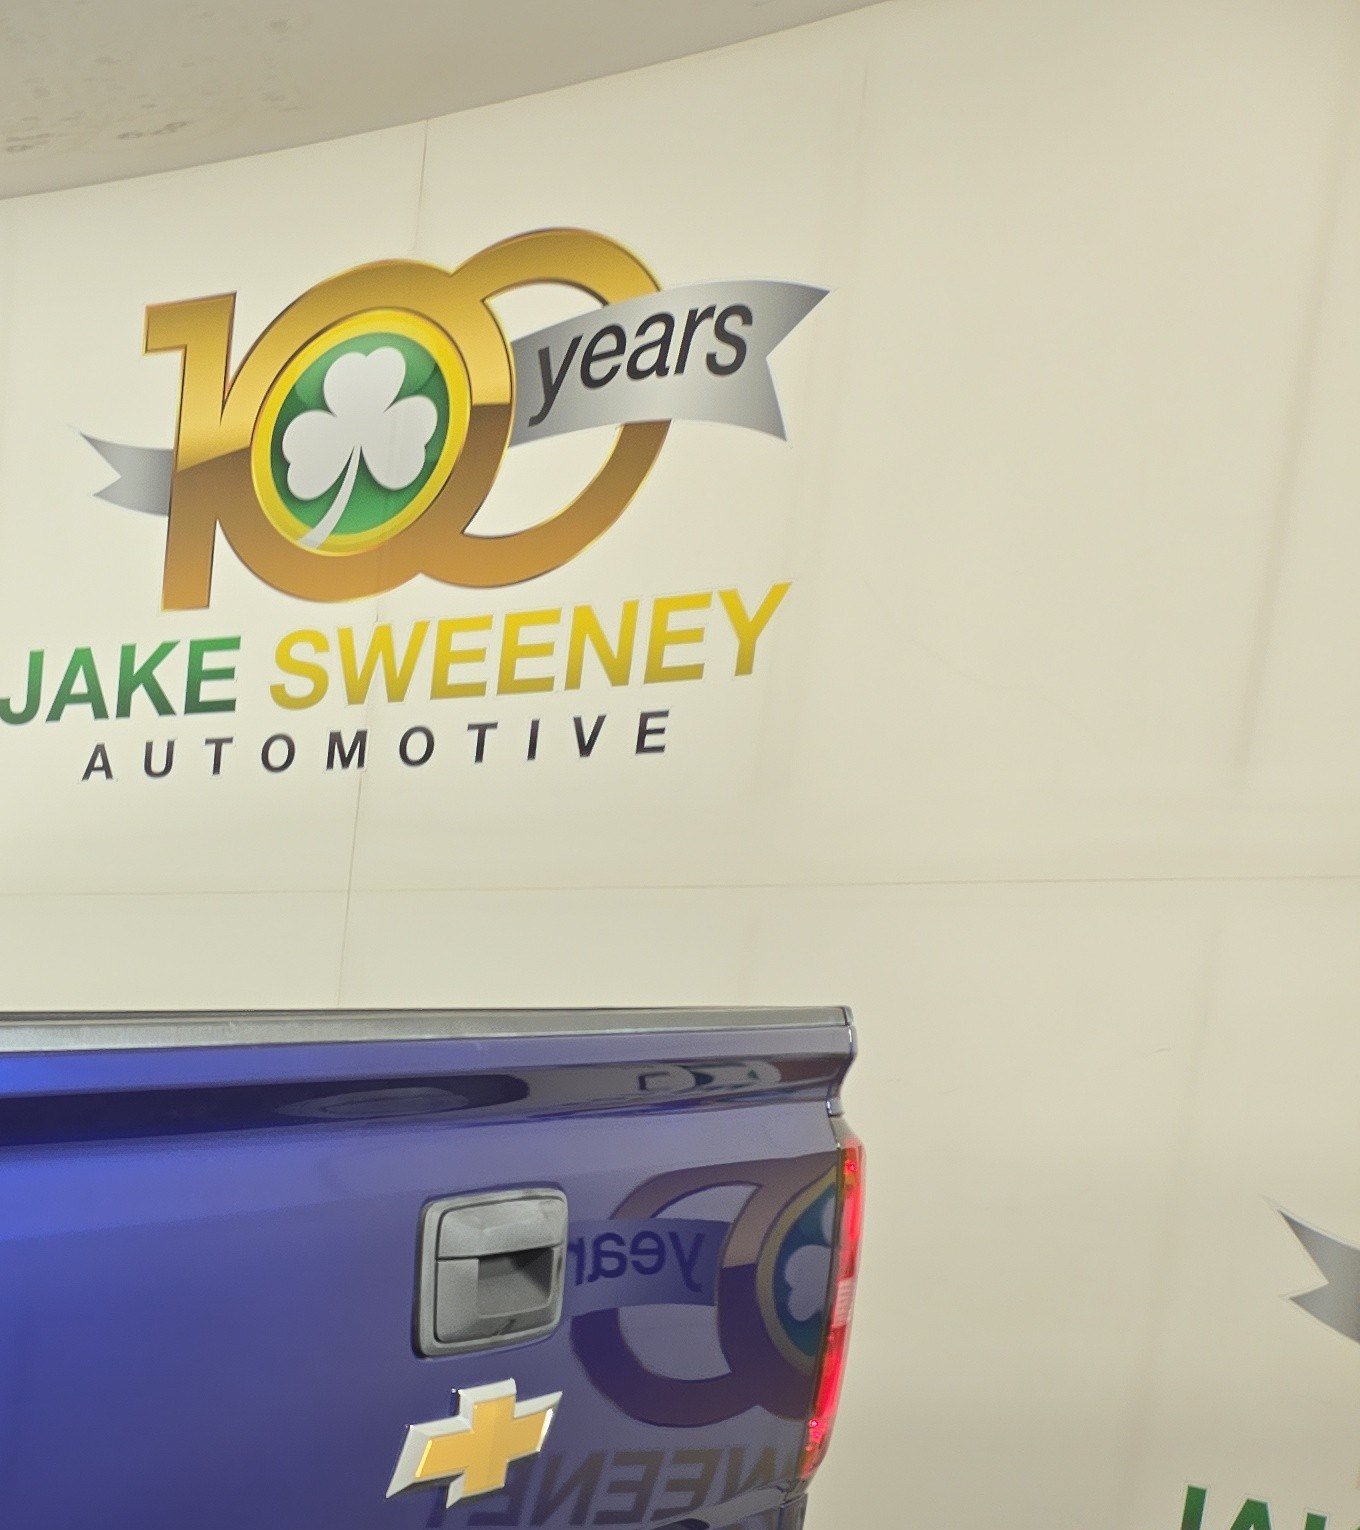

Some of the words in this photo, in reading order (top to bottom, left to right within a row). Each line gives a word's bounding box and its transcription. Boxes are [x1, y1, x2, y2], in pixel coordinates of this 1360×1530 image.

[144, 226, 674, 611] 100
[526, 300, 754, 428] years
[269, 581, 793, 712] SWEENEY
[81, 709, 671, 783] AUTOMOTIVE
